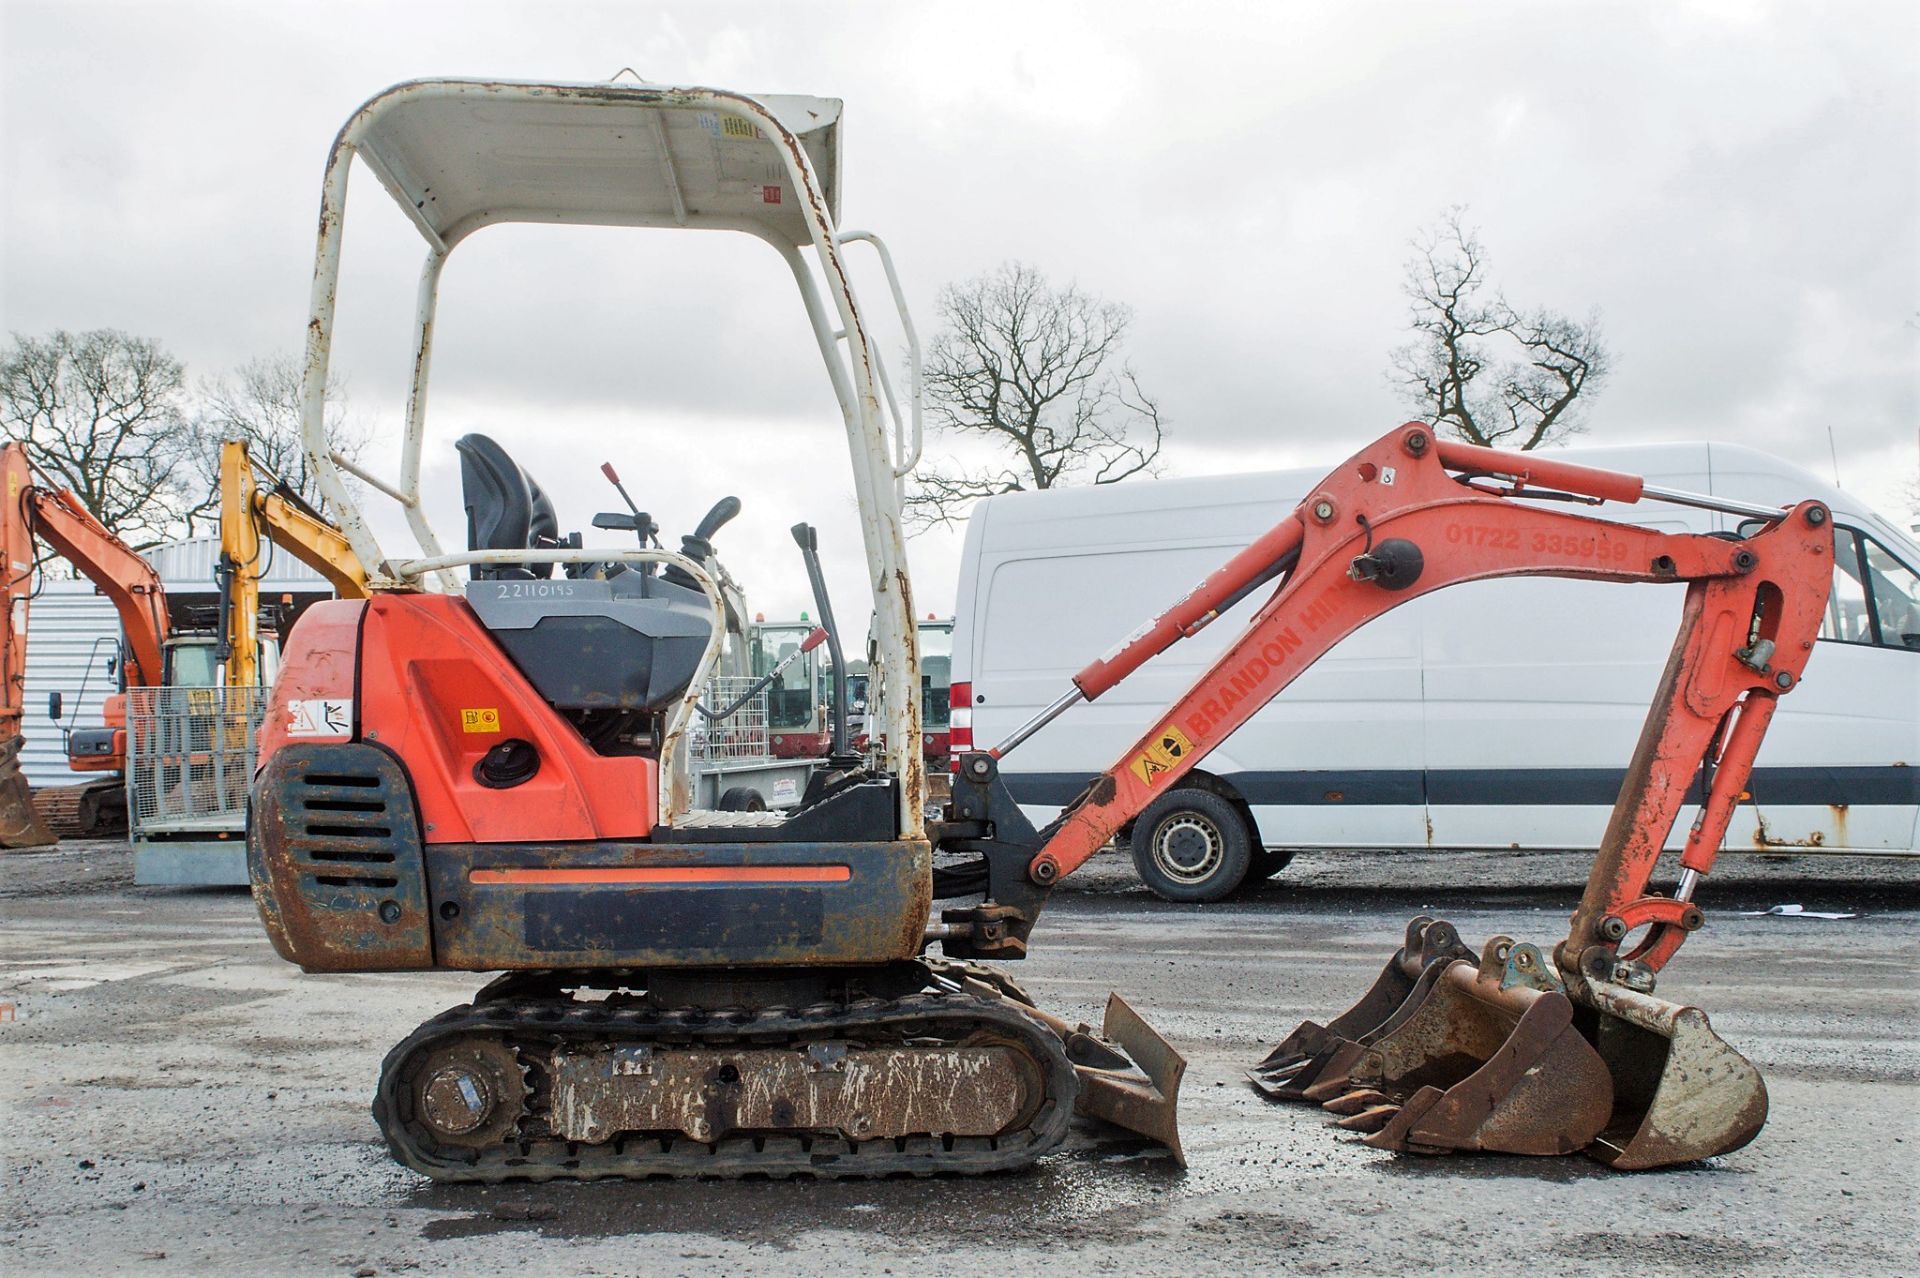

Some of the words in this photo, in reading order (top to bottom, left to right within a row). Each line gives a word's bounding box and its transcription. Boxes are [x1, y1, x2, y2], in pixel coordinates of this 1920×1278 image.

[1445, 523, 1521, 550] 01722
[1531, 532, 1628, 562] 335959
[497, 584, 574, 599] 22110195
[1185, 626, 1304, 738] BRANDON
